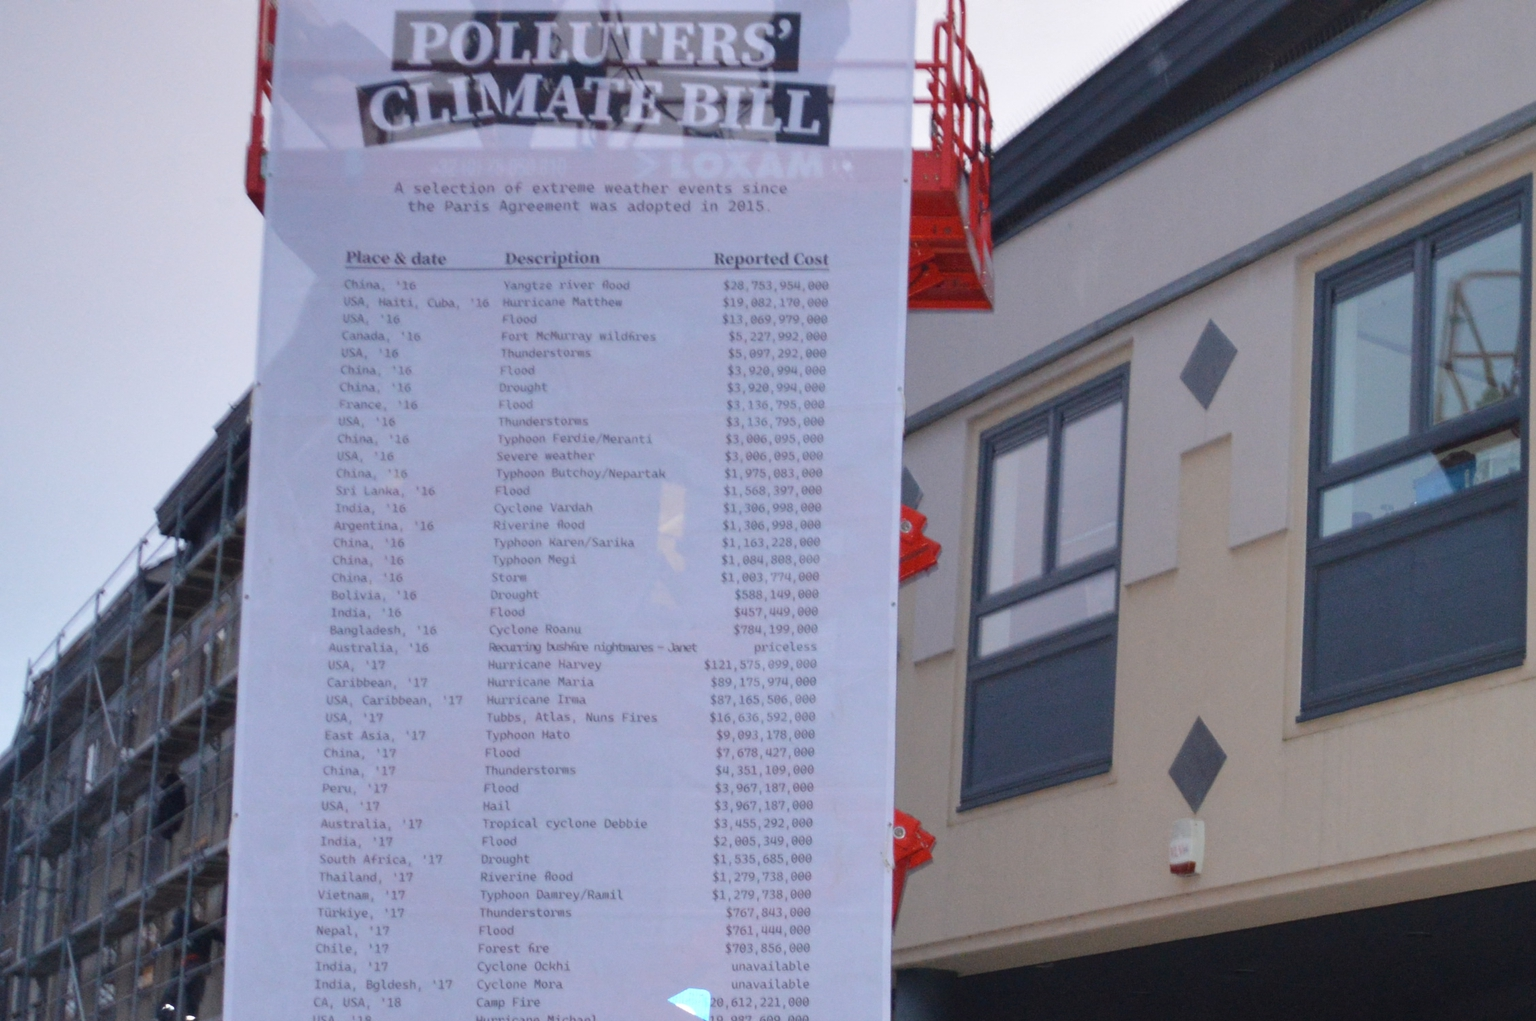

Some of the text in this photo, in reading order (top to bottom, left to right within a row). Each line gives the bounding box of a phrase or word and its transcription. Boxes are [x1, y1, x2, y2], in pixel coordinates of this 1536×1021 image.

[406, 17, 793, 68] POLLUTERS'
[368, 71, 820, 134] CLIMATE BILL
[394, 181, 788, 195] A selection of extreme weather events since
[408, 199, 770, 215] the Paris Agreement was adopted in 2015.
[345, 250, 830, 269] Place & date Description Reported Cost
[343, 279, 830, 293] China, '16 Yangtze river flood $28,753,954,000
[343, 296, 830, 309] USA, Haiti, Cuba, '16 Hurricane Matthew $19,082,170,000
[341, 331, 828, 344] Canada, '16 Fort McMurray wildfires $5,227,992,000
[337, 433, 825, 446] China, '16 Typhoon Ferdie/Meranti $3,006,095,000
[335, 485, 823, 497] Sri Lanka, '16 Flood $1,568,397,000
[328, 642, 399, 655] Australia,
[409, 643, 430, 653] '16
[488, 642, 542, 655] Recurring
[545, 642, 589, 653] bushfire
[592, 642, 656, 655] nightmares
[667, 642, 699, 653] Janet
[753, 641, 818, 654] priceless
[324, 711, 817, 724] USA, '17 Tubbs, Atlas, Nuns Fires $16,636,592,000
[320, 817, 814, 831] Australia, '17 Tropical cyclone Debbie $3,455,292,000
[317, 889, 813, 903] Vietnam, '17 Typhoon Damrey/Ramil $1,279,738,000
[315, 960, 811, 974] India, '17 Cyclone Ockhi unavailable
